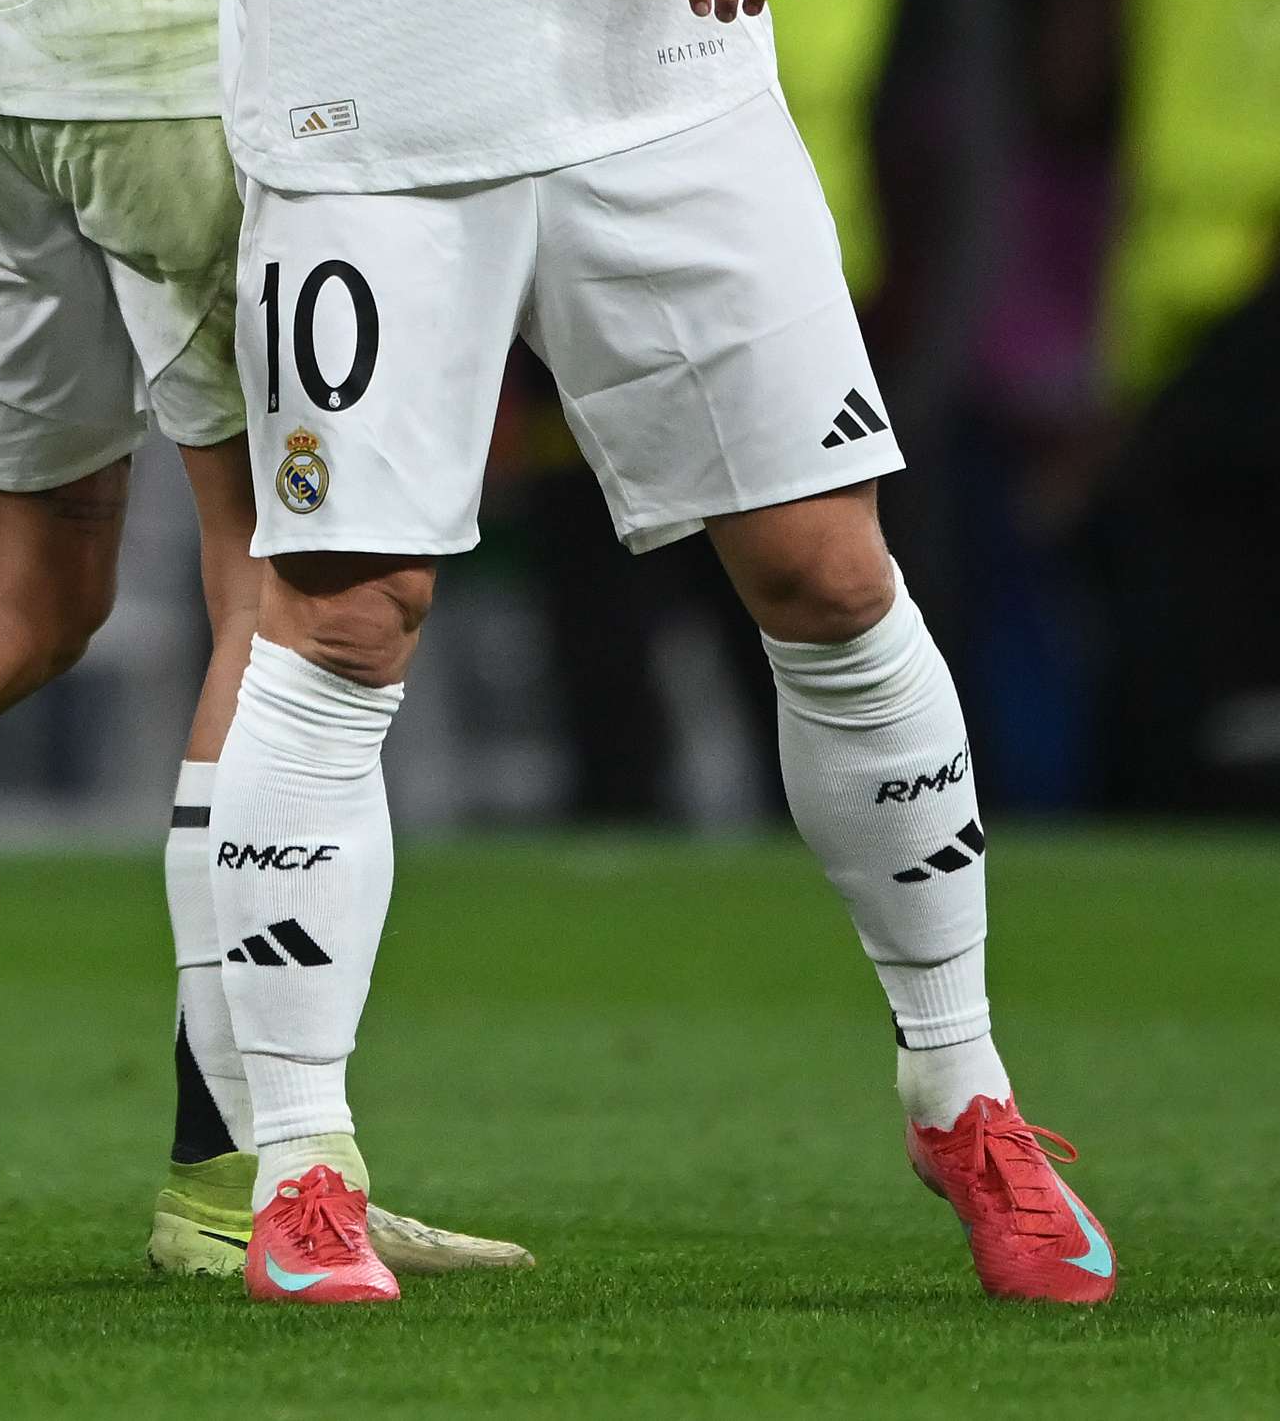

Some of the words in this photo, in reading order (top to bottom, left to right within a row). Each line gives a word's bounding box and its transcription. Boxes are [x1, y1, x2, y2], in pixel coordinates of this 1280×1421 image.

[657, 37, 725, 65] HEAT.RDY
[259, 259, 380, 414] 10
[217, 841, 340, 870] RMCF
